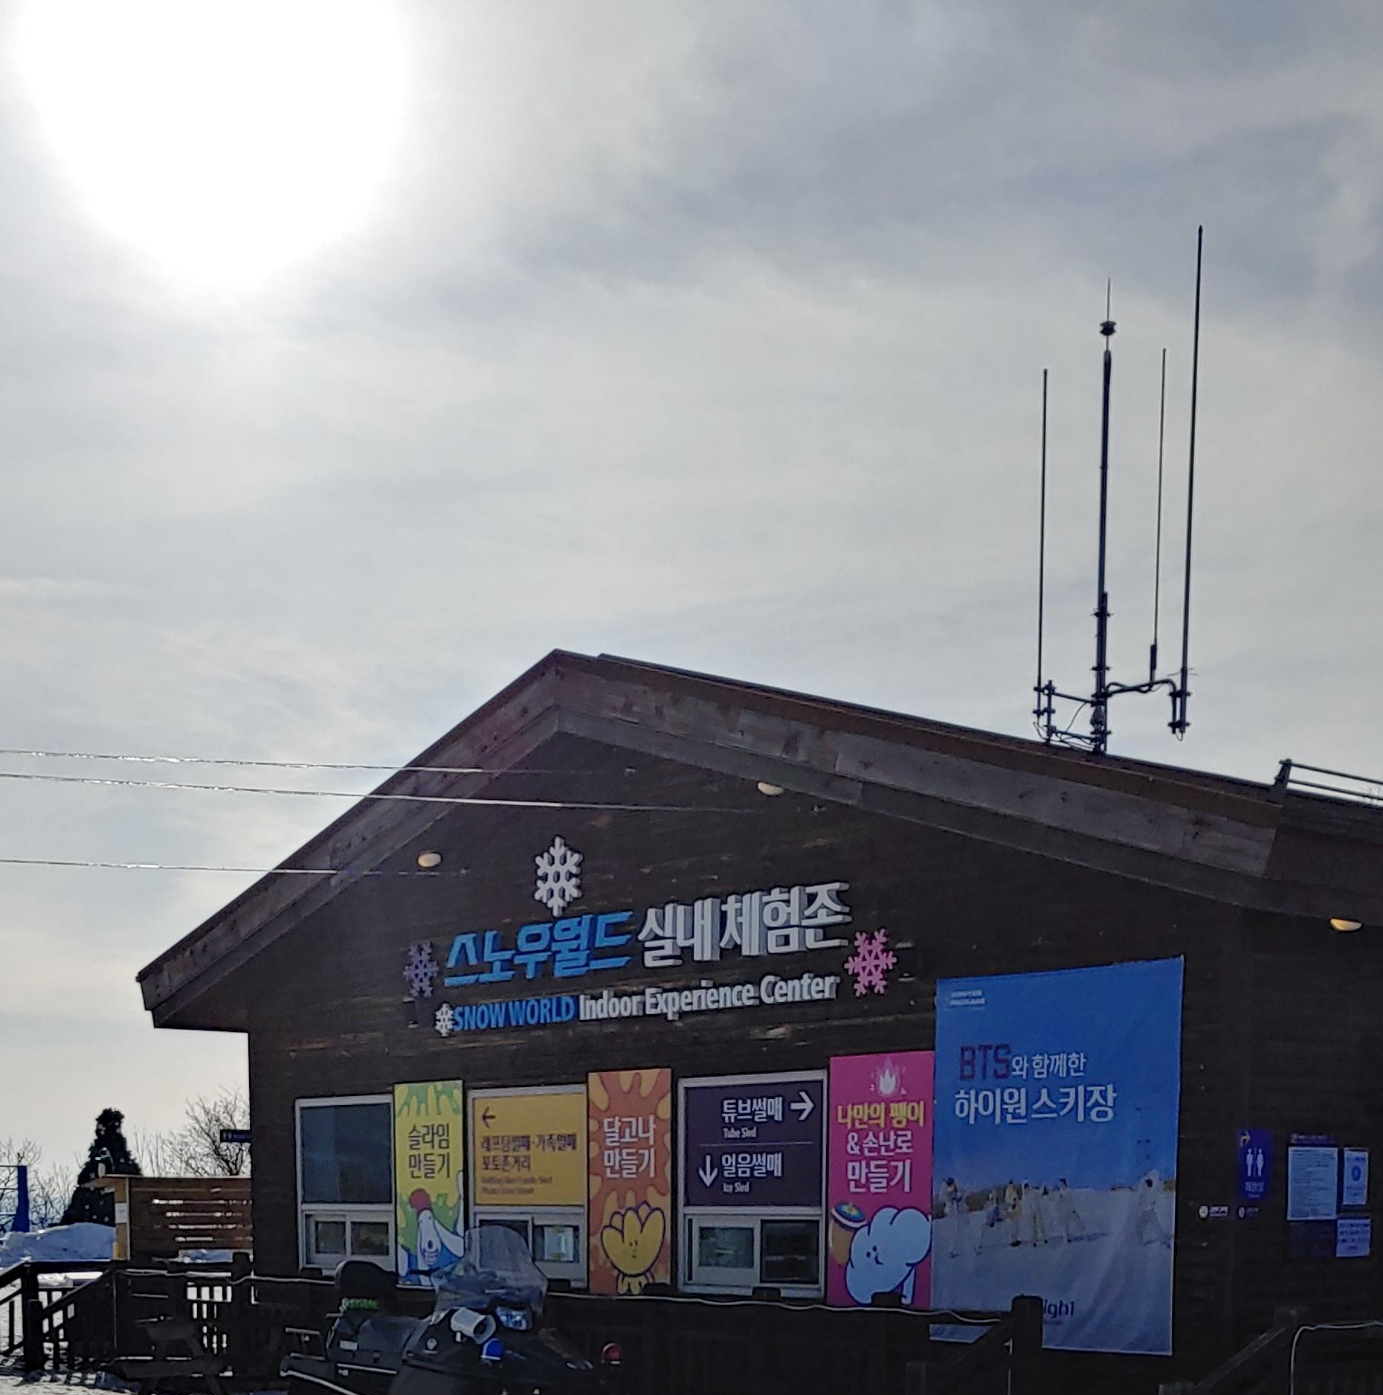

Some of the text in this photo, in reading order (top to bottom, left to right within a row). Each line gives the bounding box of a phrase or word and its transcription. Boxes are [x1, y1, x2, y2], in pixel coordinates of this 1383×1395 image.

[444, 910, 634, 987] 스노우월드
[454, 973, 840, 1032] SNOW WORLD Indoor Experience Center
[1031, 1052, 1087, 1079] 함께한
[721, 1096, 783, 1123] 튜브썰매
[837, 1100, 924, 1129] 나만의 팽이
[408, 1122, 451, 1150] 슬라임
[603, 1115, 656, 1145] 달고나
[862, 1130, 913, 1156] 손난로
[408, 1152, 451, 1179] 만들기
[603, 1147, 656, 1179] 만들기
[721, 1152, 782, 1177] 얼음썰매
[847, 1159, 911, 1193] 만들기
